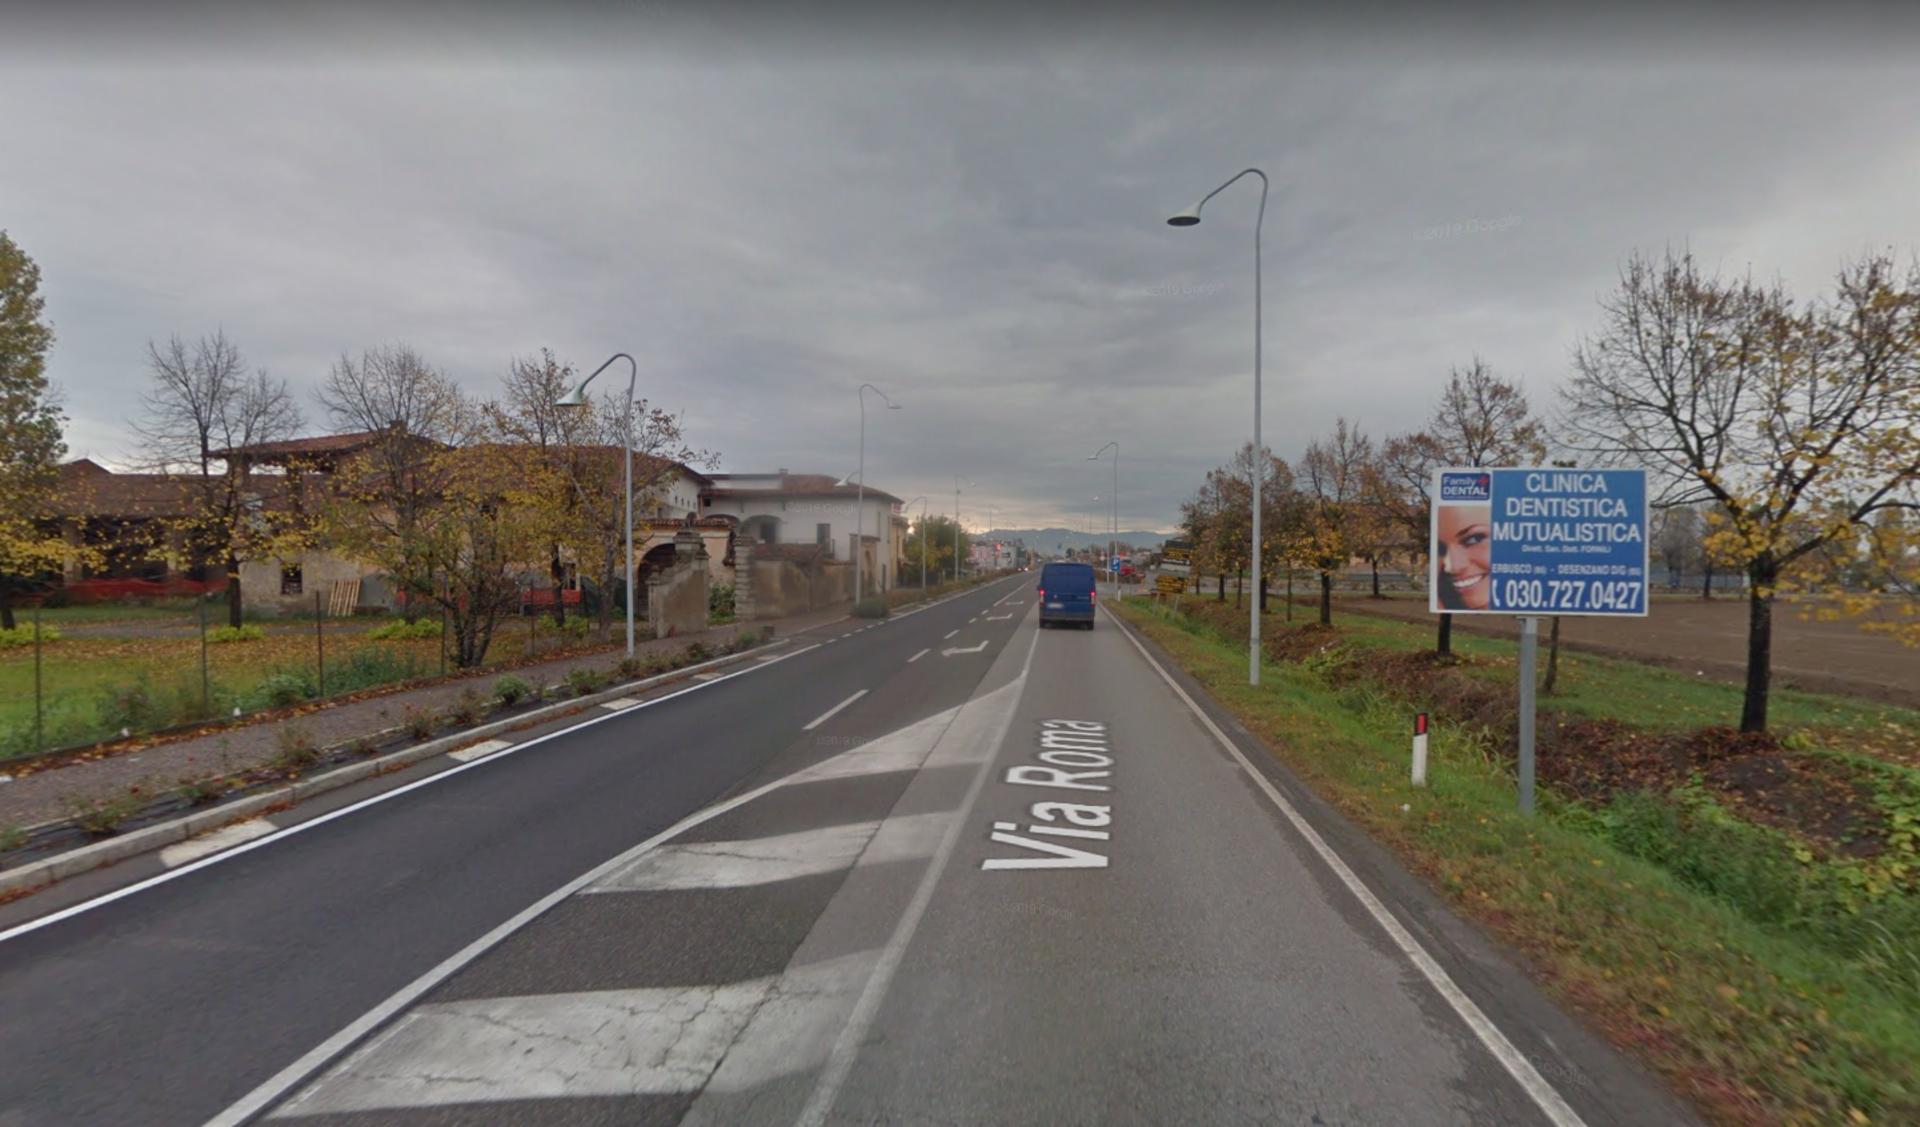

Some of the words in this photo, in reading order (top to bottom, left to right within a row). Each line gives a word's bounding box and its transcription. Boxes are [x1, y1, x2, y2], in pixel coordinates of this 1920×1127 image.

[1443, 476, 1476, 488] Family
[1443, 486, 1488, 496] DENTAL
[1525, 473, 1608, 493] CLINICA
[1506, 498, 1628, 518] DENTISTICA
[1493, 522, 1642, 543] MUTUALISTICA
[1491, 563, 1532, 574] ERBUSCO
[1557, 564, 1609, 575] DESENZANO
[1506, 579, 1642, 610] 030.727.0427
